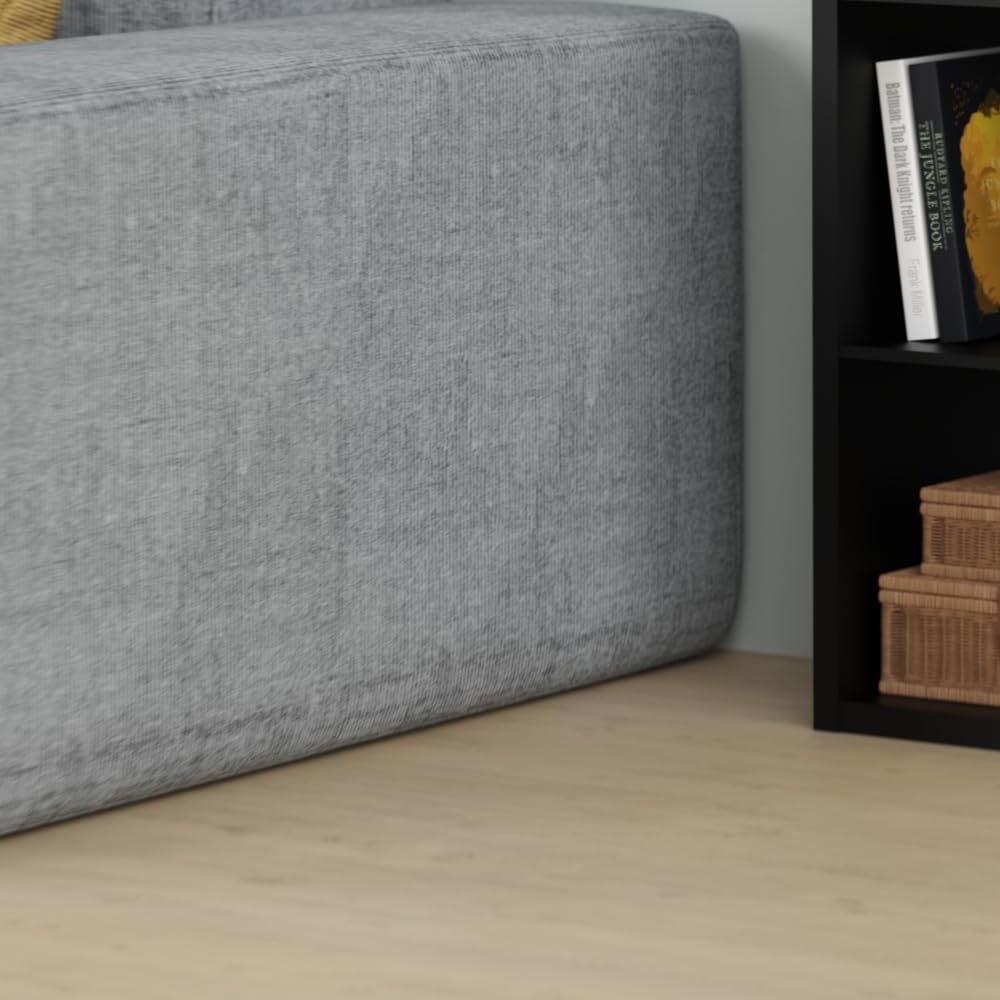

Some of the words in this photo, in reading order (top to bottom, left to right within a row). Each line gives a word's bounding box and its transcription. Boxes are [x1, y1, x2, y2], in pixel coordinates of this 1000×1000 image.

[891, 126, 905, 144] The
[919, 120, 931, 149] THE
[893, 145, 910, 168] Dark
[935, 133, 949, 185] RUDYARD
[896, 169, 913, 203] Knight
[920, 153, 938, 208] JUNGLE
[900, 204, 917, 242] returns
[940, 188, 954, 233] KIPLING
[929, 213, 943, 251] BOOK
